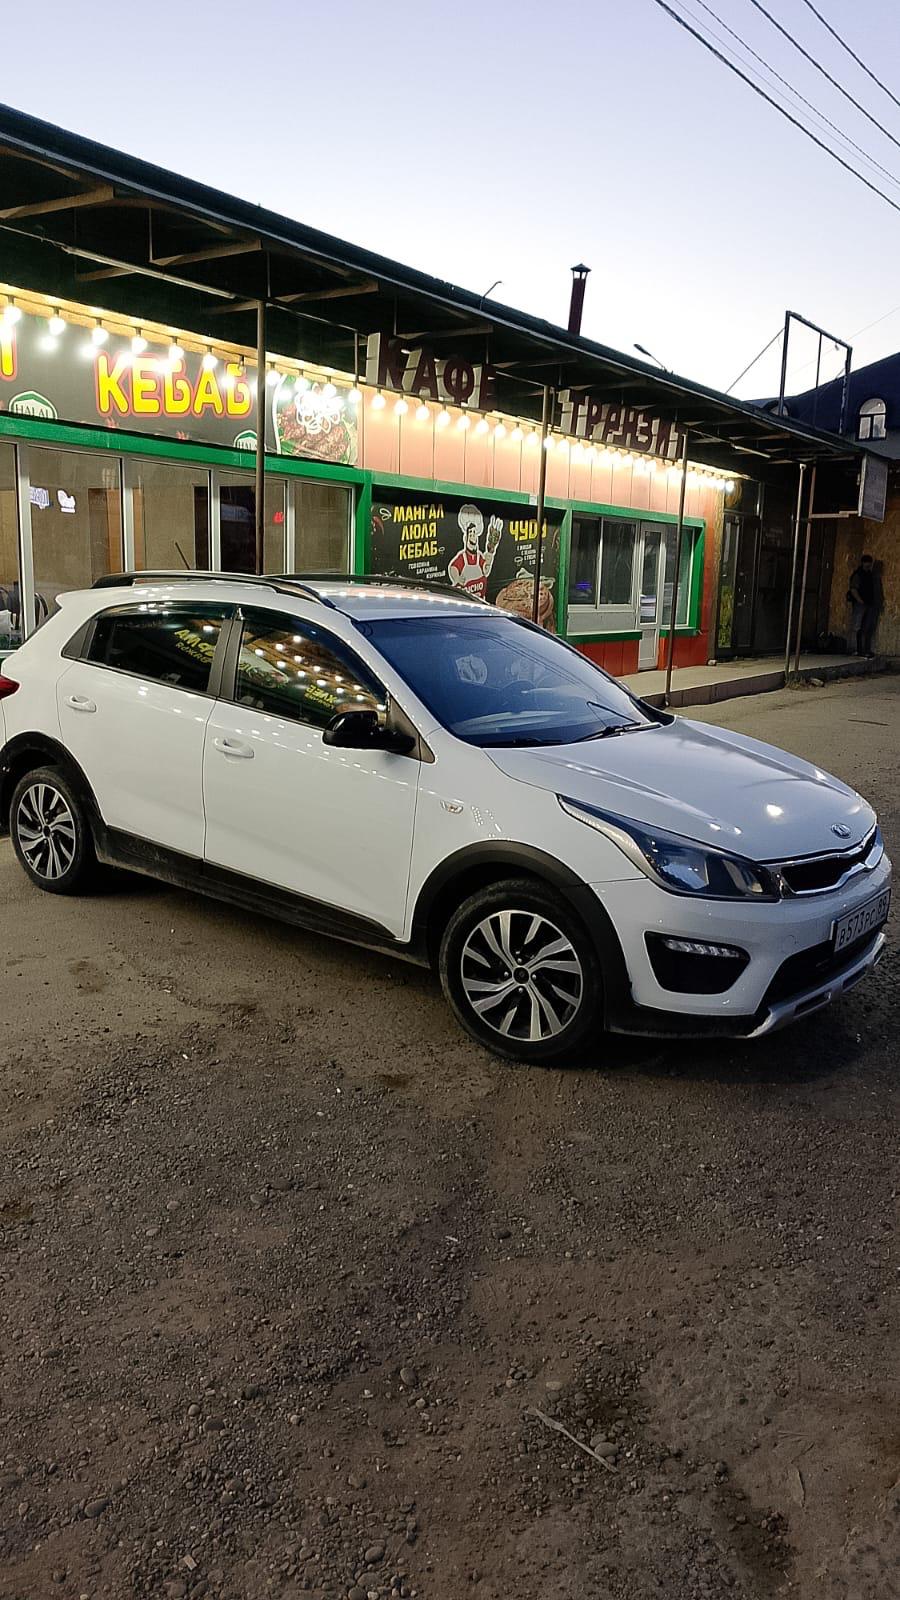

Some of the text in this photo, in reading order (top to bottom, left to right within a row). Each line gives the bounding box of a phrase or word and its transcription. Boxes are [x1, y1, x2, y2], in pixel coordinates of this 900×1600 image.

[367, 328, 497, 412] КАФЕ
[96, 353, 252, 417] КЕБАБ
[393, 503, 444, 523] МАНГАЛ
[401, 522, 437, 541] ЛЮЛЯ
[399, 540, 438, 561] КЕБАБ
